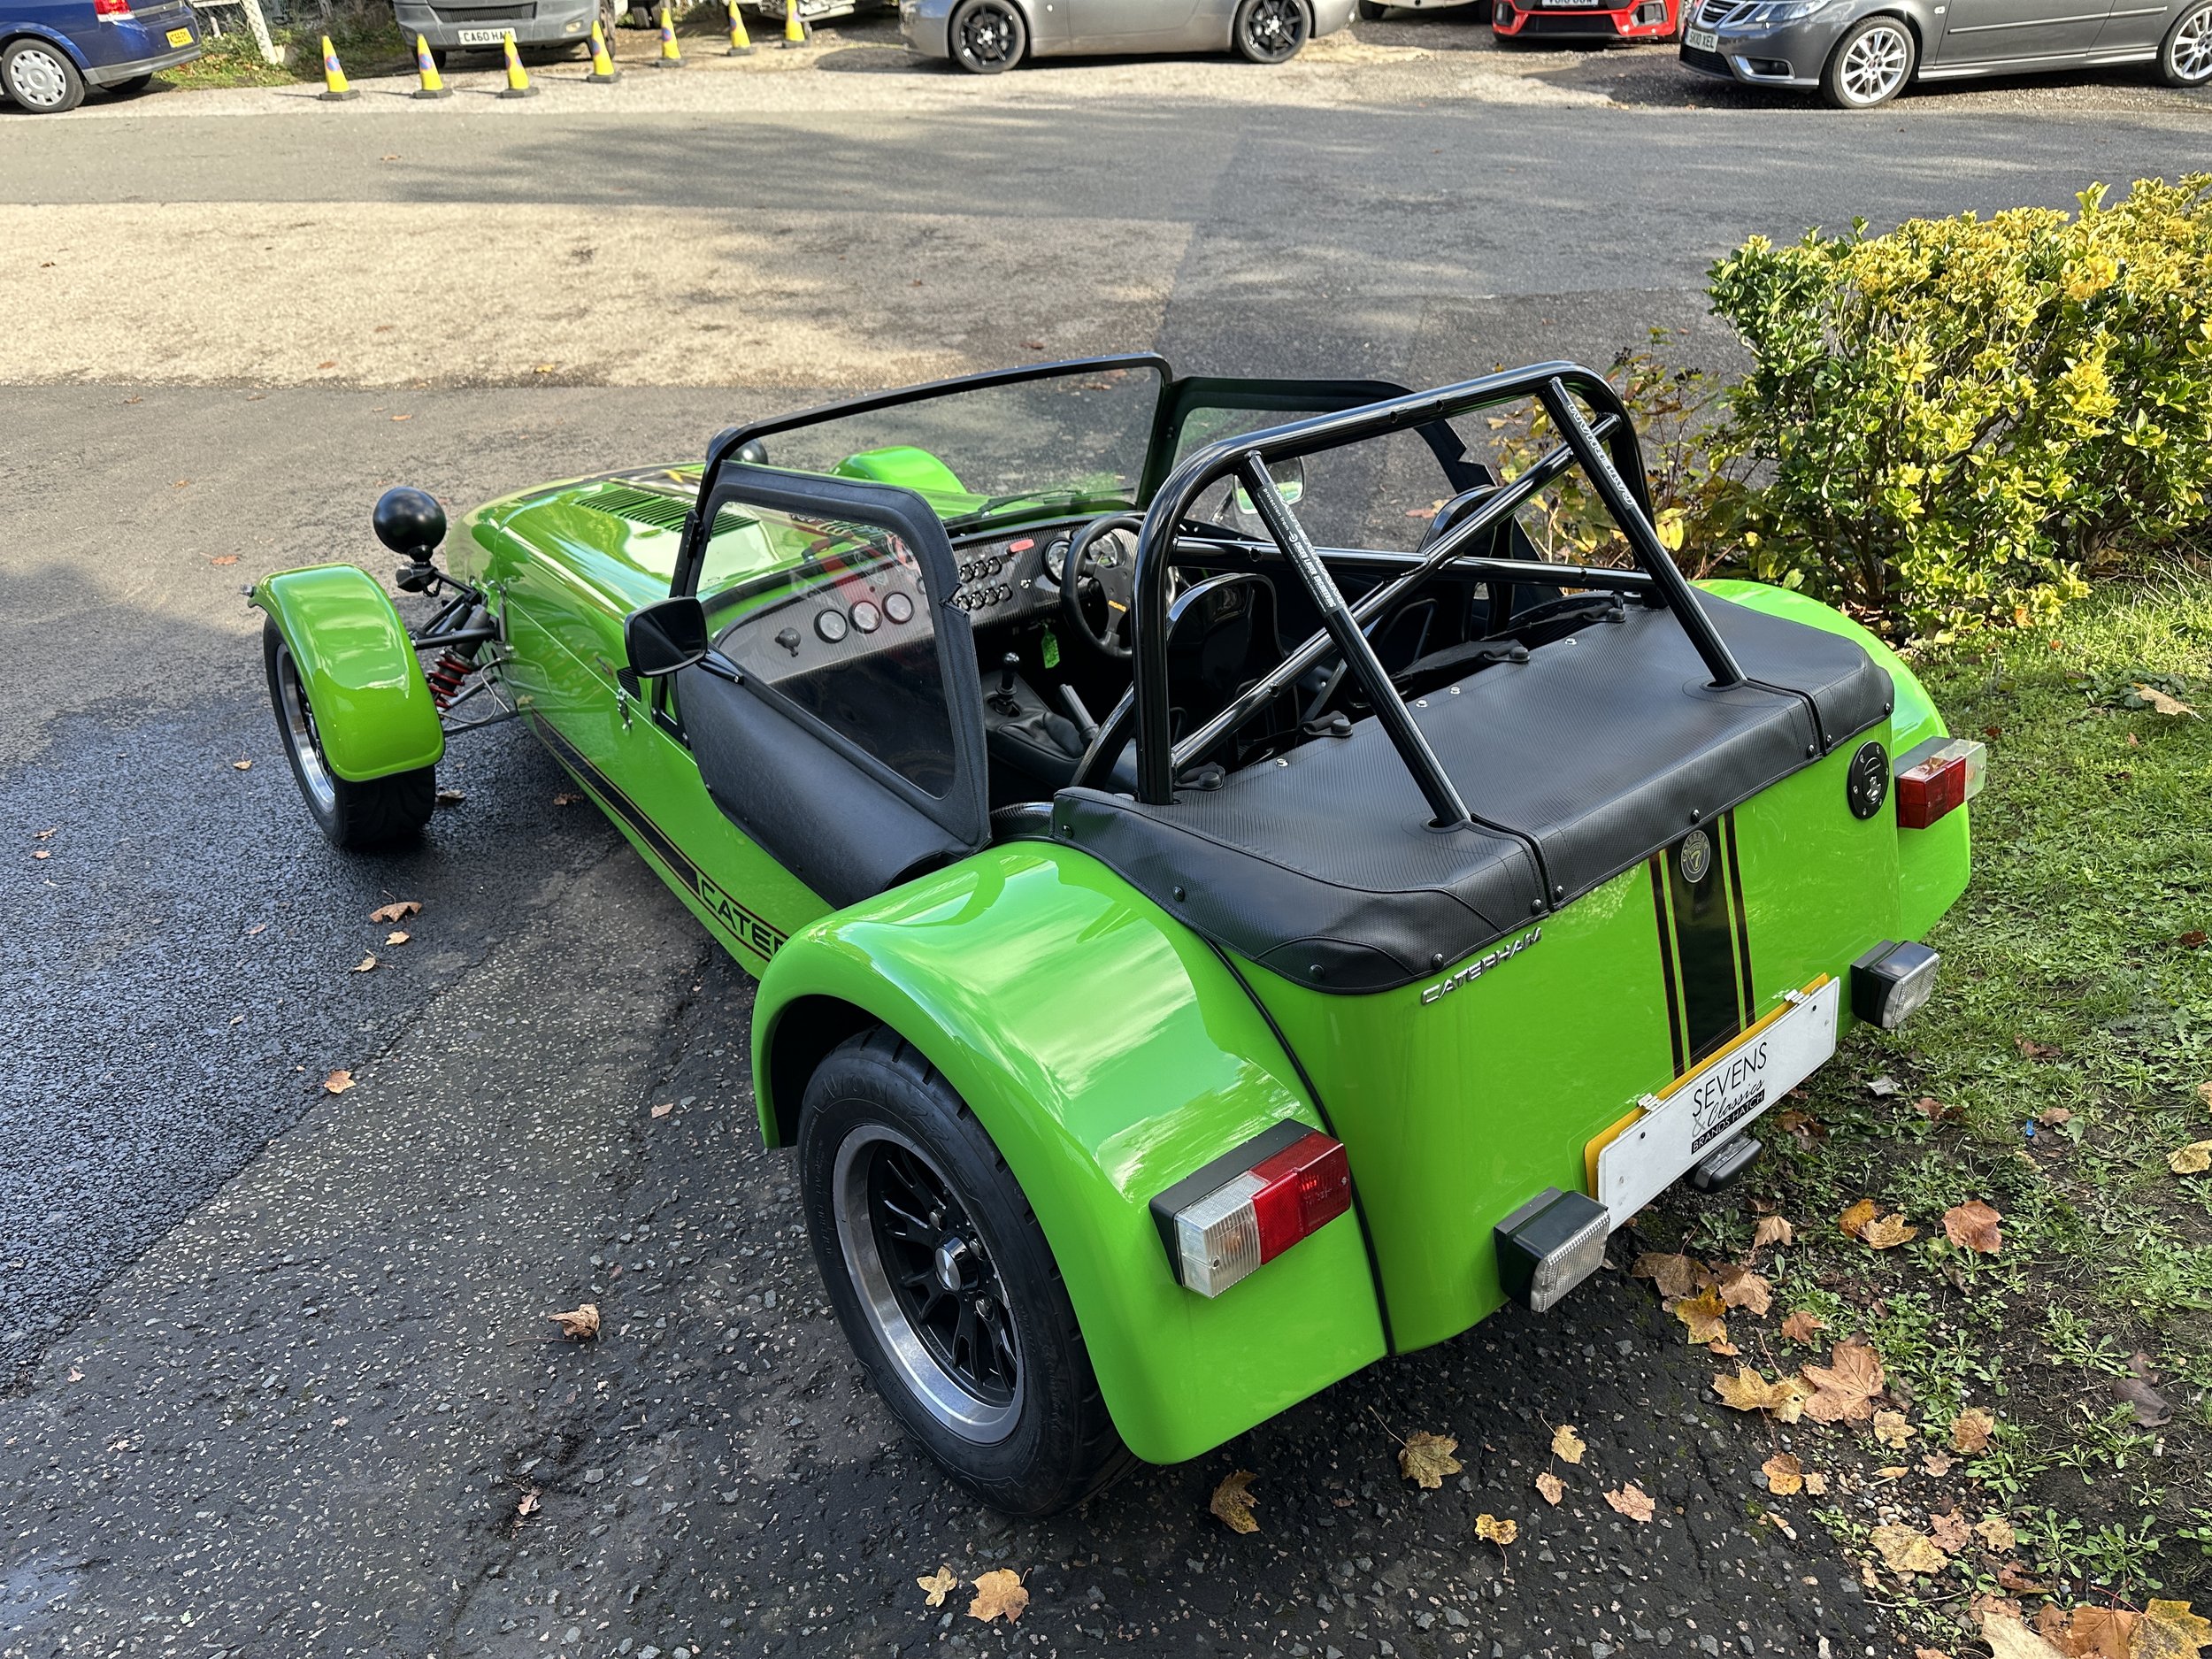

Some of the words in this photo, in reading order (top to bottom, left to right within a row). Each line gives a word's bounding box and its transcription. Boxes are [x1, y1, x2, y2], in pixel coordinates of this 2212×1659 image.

[464, 32, 490, 42] CA60
[1702, 35, 1715, 49] XEL
[1263, 488, 1282, 517] protection
[1280, 516, 1290, 531] from
[1303, 558, 1318, 575] LASER
[1691, 850, 1701, 868] 7
[1421, 926, 1542, 1005] CATERHAM
[1693, 1041, 1767, 1117] SEVENS
[1708, 1079, 1764, 1127] Classics
[1693, 1118, 1731, 1152] BRANDS
[1732, 1093, 1763, 1123] HATCH
